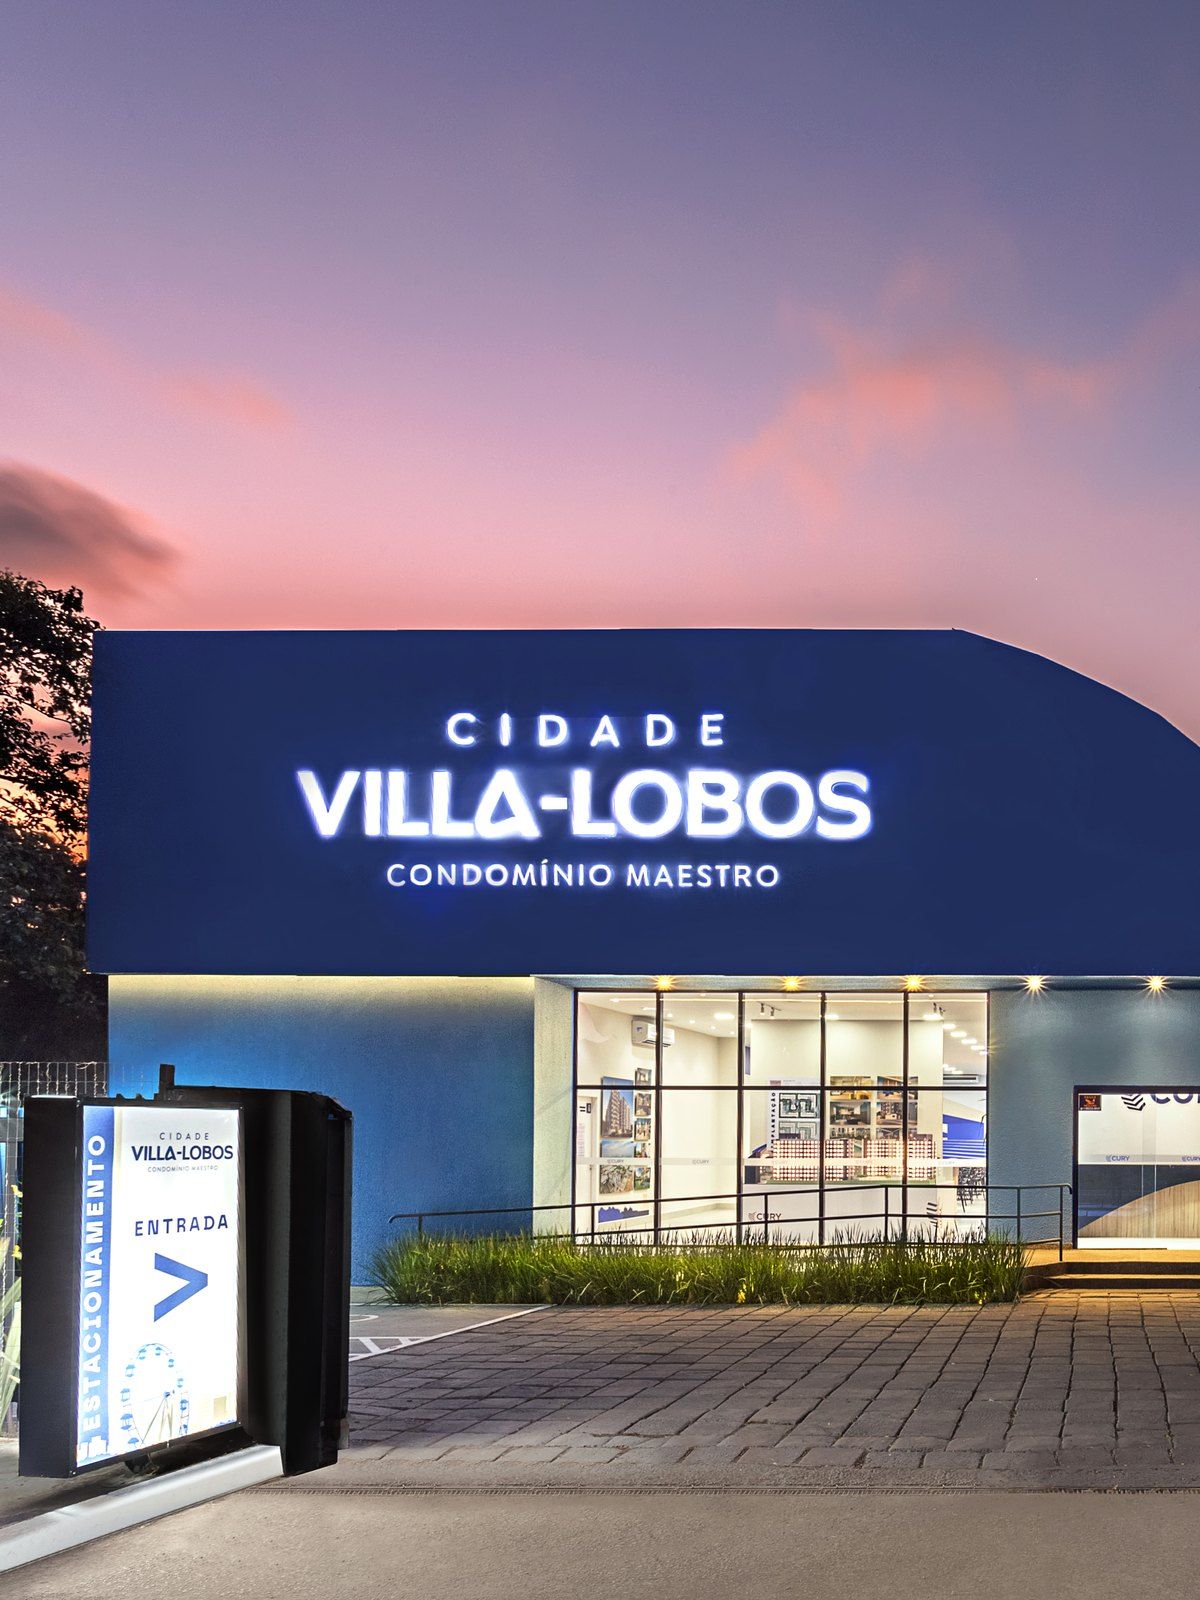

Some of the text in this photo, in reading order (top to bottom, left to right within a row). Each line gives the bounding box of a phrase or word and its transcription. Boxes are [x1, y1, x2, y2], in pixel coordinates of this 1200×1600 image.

[444, 711, 725, 748] CIDADE
[296, 768, 872, 841] VILLA-LOBOS
[386, 858, 779, 888] CONDOMÍNIO MAESTRO
[159, 1132, 210, 1141] CIDADE
[131, 1145, 234, 1161] VILLA-LOBOS
[134, 1214, 228, 1236] ENTRADA
[82, 1134, 107, 1432] ESTACIONAMENTO
